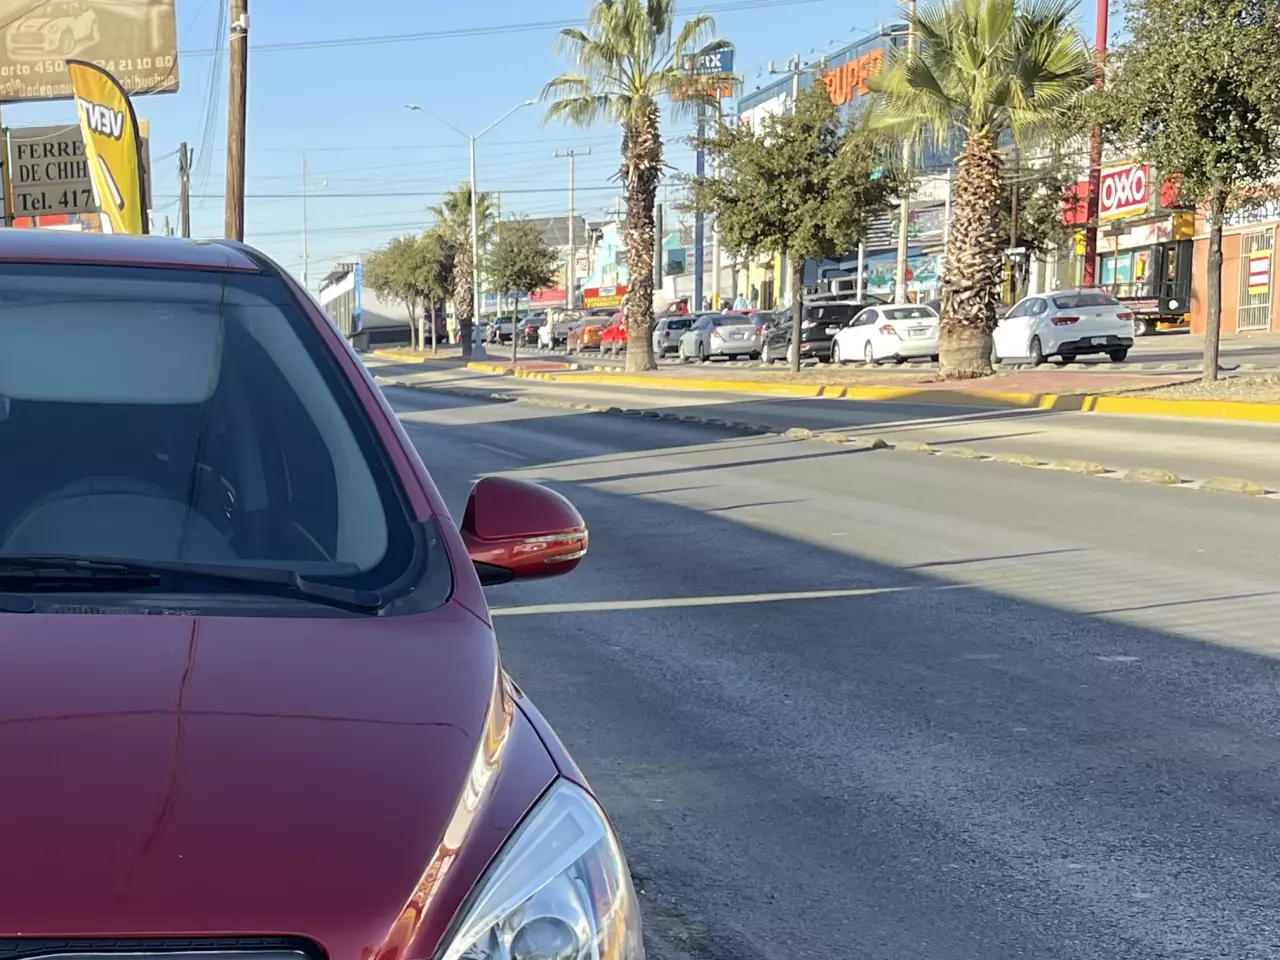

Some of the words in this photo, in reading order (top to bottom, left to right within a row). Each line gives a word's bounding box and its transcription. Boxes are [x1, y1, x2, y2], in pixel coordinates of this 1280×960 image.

[118, 60, 133, 71] 21
[137, 58, 151, 70] 10
[155, 56, 174, 68] 80
[17, 141, 86, 160] FERRE
[20, 163, 41, 183] DE
[45, 160, 87, 181] CHIH
[18, 192, 52, 212] Tel.
[59, 189, 95, 208] 417
[1102, 168, 1146, 211] OXXO
